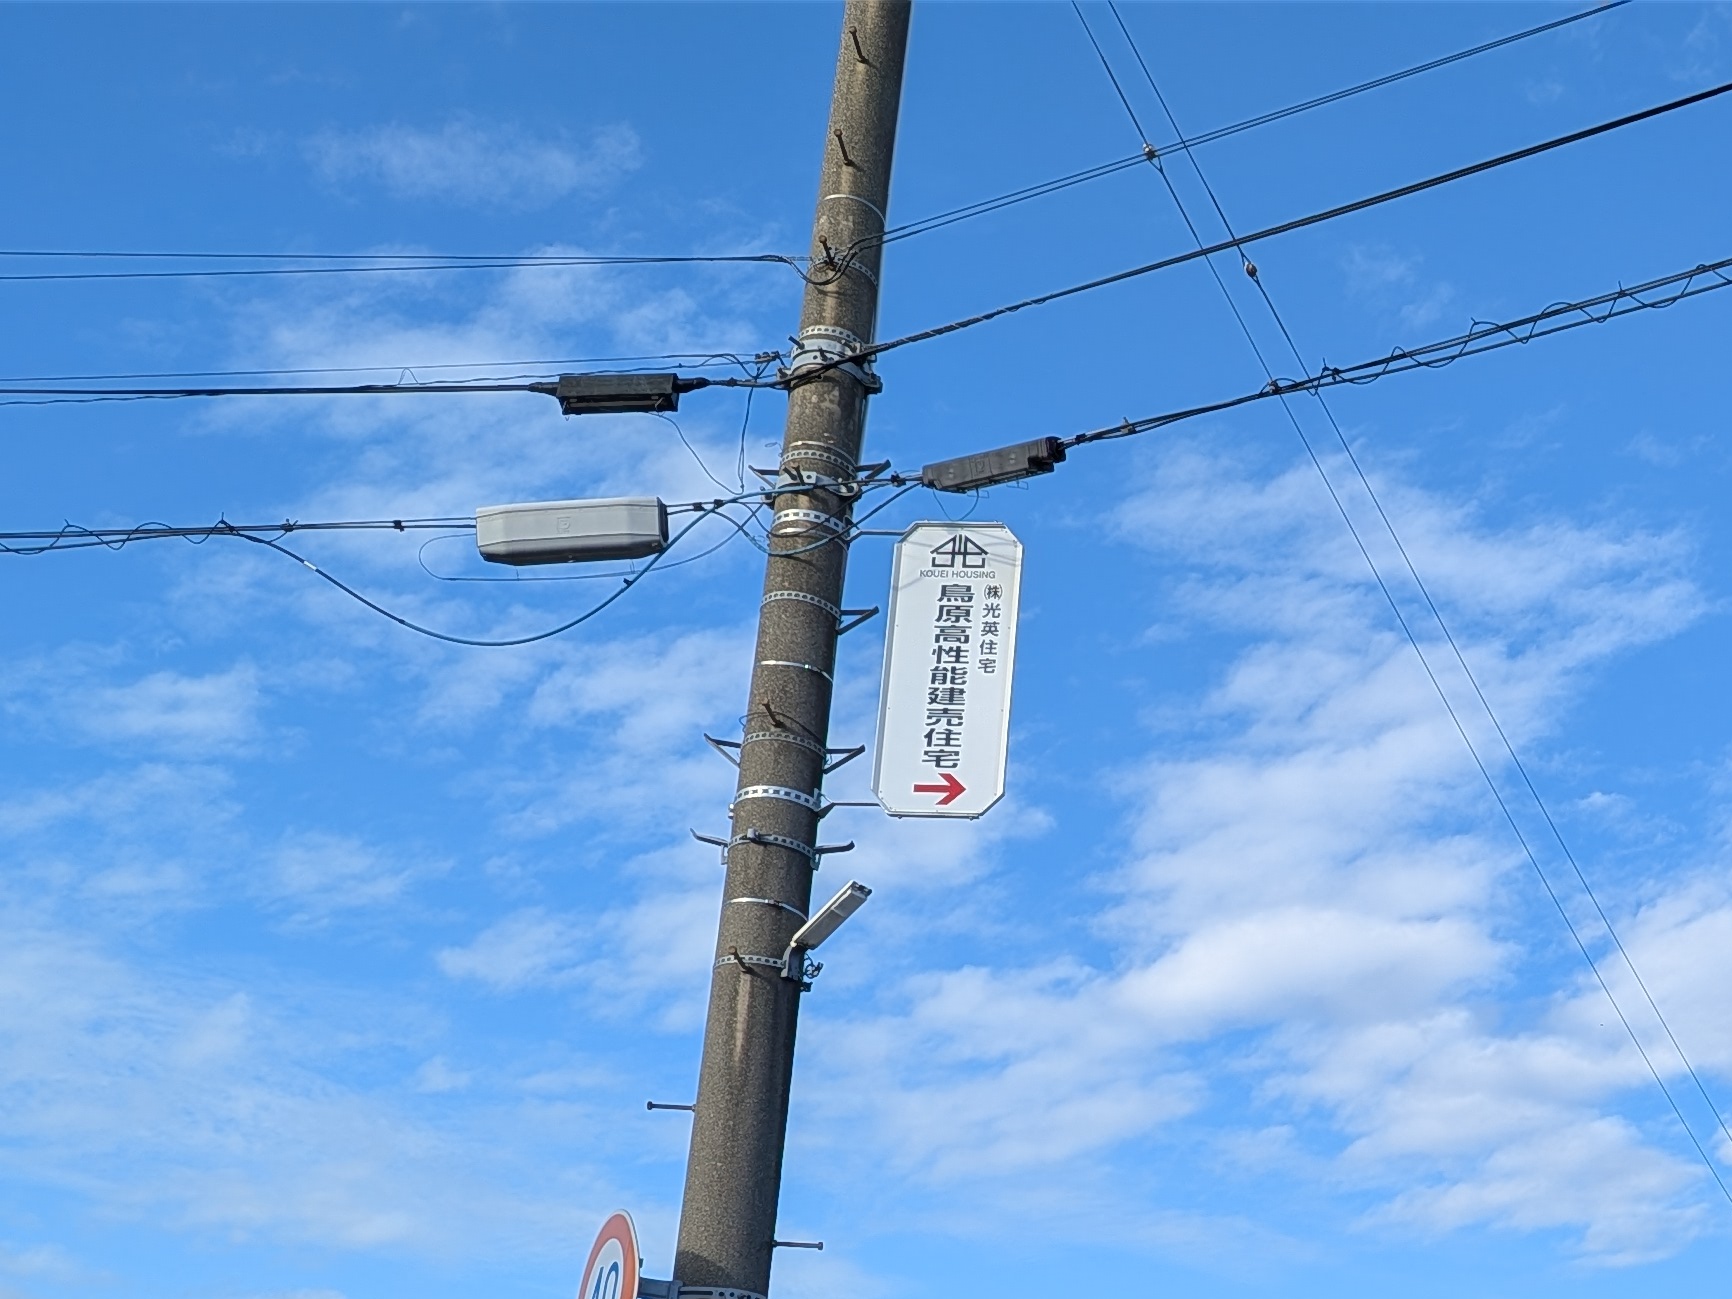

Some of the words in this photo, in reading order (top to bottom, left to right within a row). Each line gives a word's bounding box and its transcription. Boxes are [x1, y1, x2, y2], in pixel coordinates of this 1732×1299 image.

[919, 569, 949, 578] KOUEI
[951, 570, 996, 579] HOUSING
[922, 583, 976, 769] 鳥原高性能建売住宅
